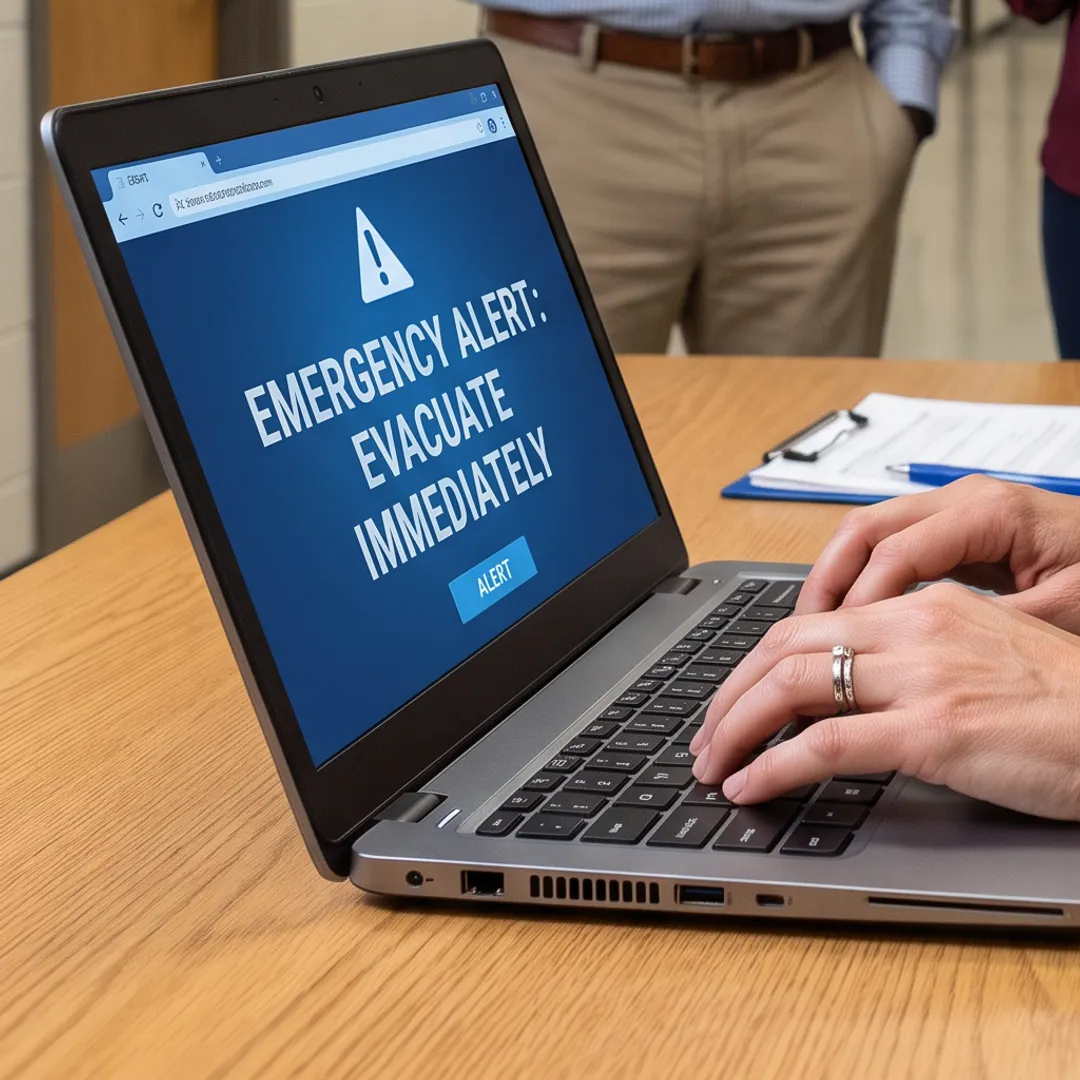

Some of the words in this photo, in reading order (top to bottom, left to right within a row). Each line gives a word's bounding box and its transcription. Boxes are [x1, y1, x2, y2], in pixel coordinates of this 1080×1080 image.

[244, 315, 450, 448] EMERGENCY
[452, 279, 548, 359] ALERT:
[351, 368, 514, 490] EVACUATE
[353, 426, 553, 581] IMMEDIATELY
[477, 558, 513, 598] ALERT
